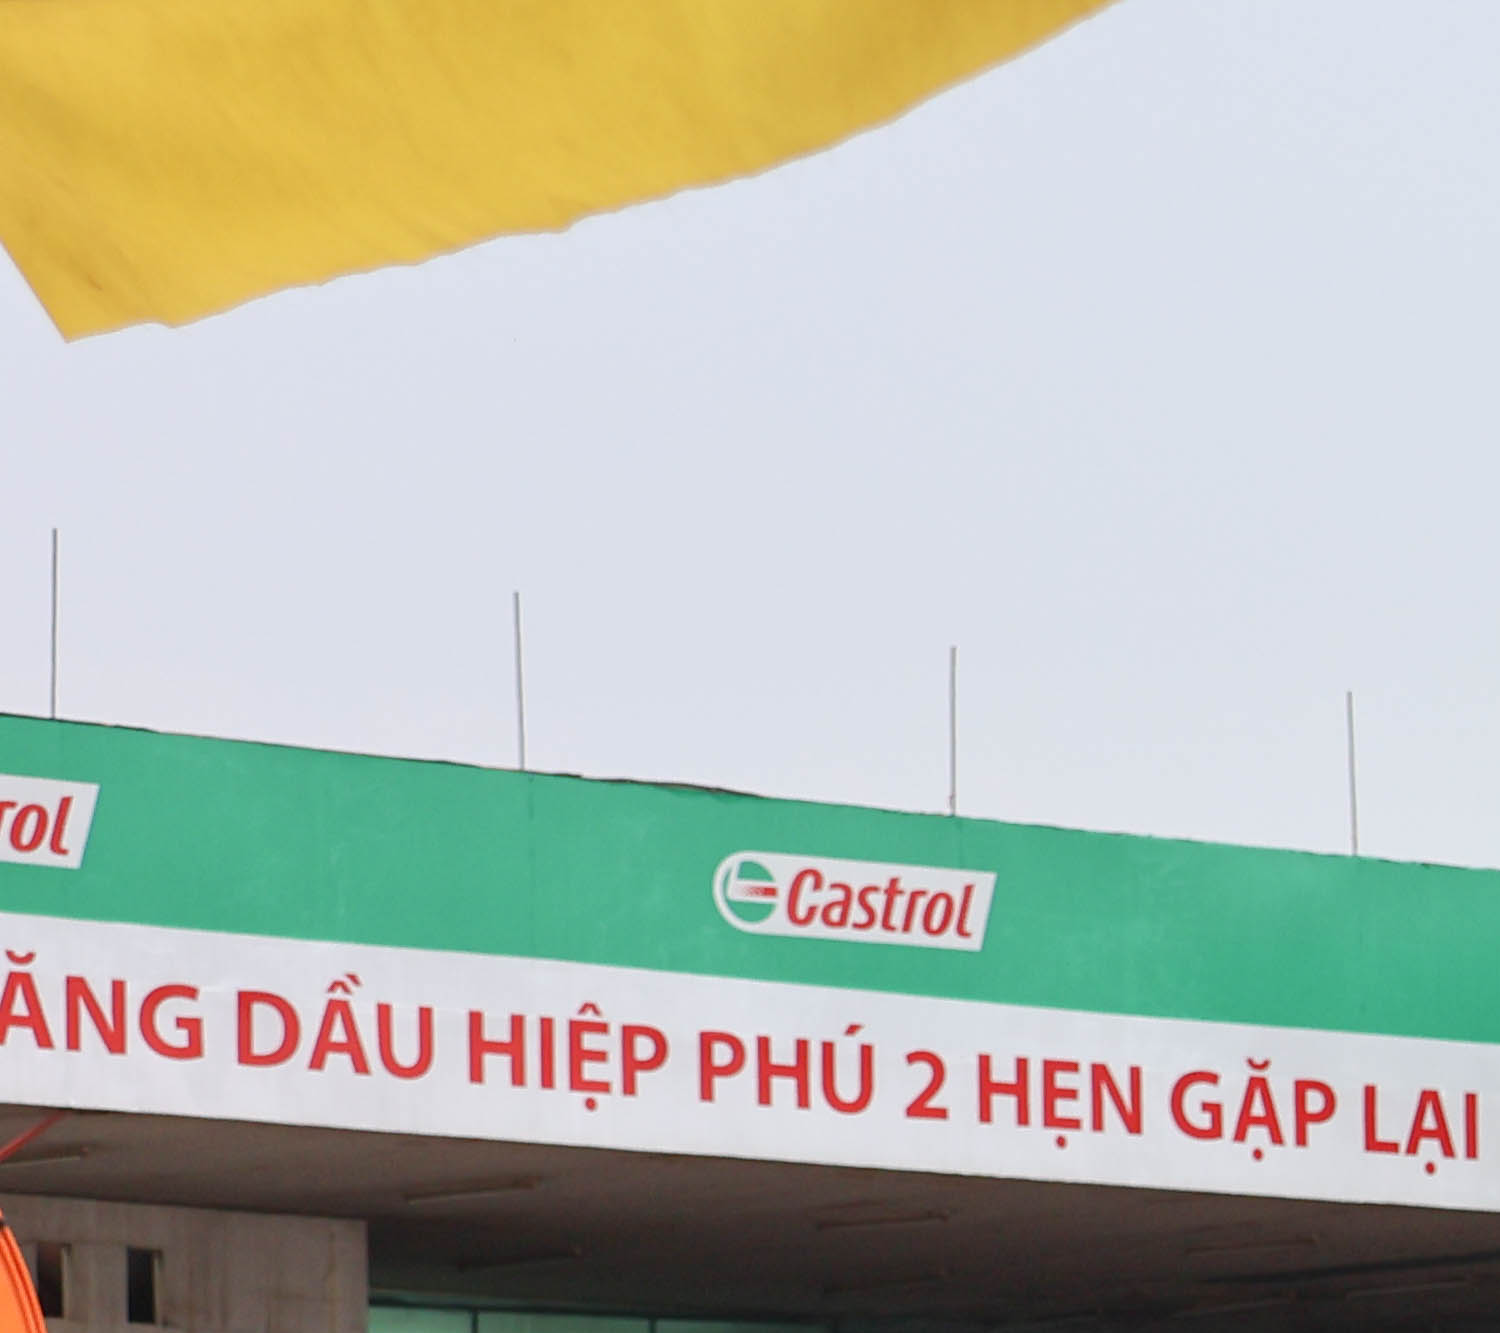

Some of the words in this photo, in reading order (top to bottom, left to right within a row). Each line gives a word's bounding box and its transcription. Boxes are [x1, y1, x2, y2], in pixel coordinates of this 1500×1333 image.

[786, 867, 975, 940] Castrol
[237, 973, 434, 1078] DẦU
[467, 1003, 668, 1111] HIỆP
[698, 1023, 876, 1116] PHÚ
[904, 1050, 948, 1119] 2
[978, 1054, 1143, 1148] HẸN
[1169, 1057, 1337, 1160] GẶP
[1363, 1084, 1480, 1175] LẠI
